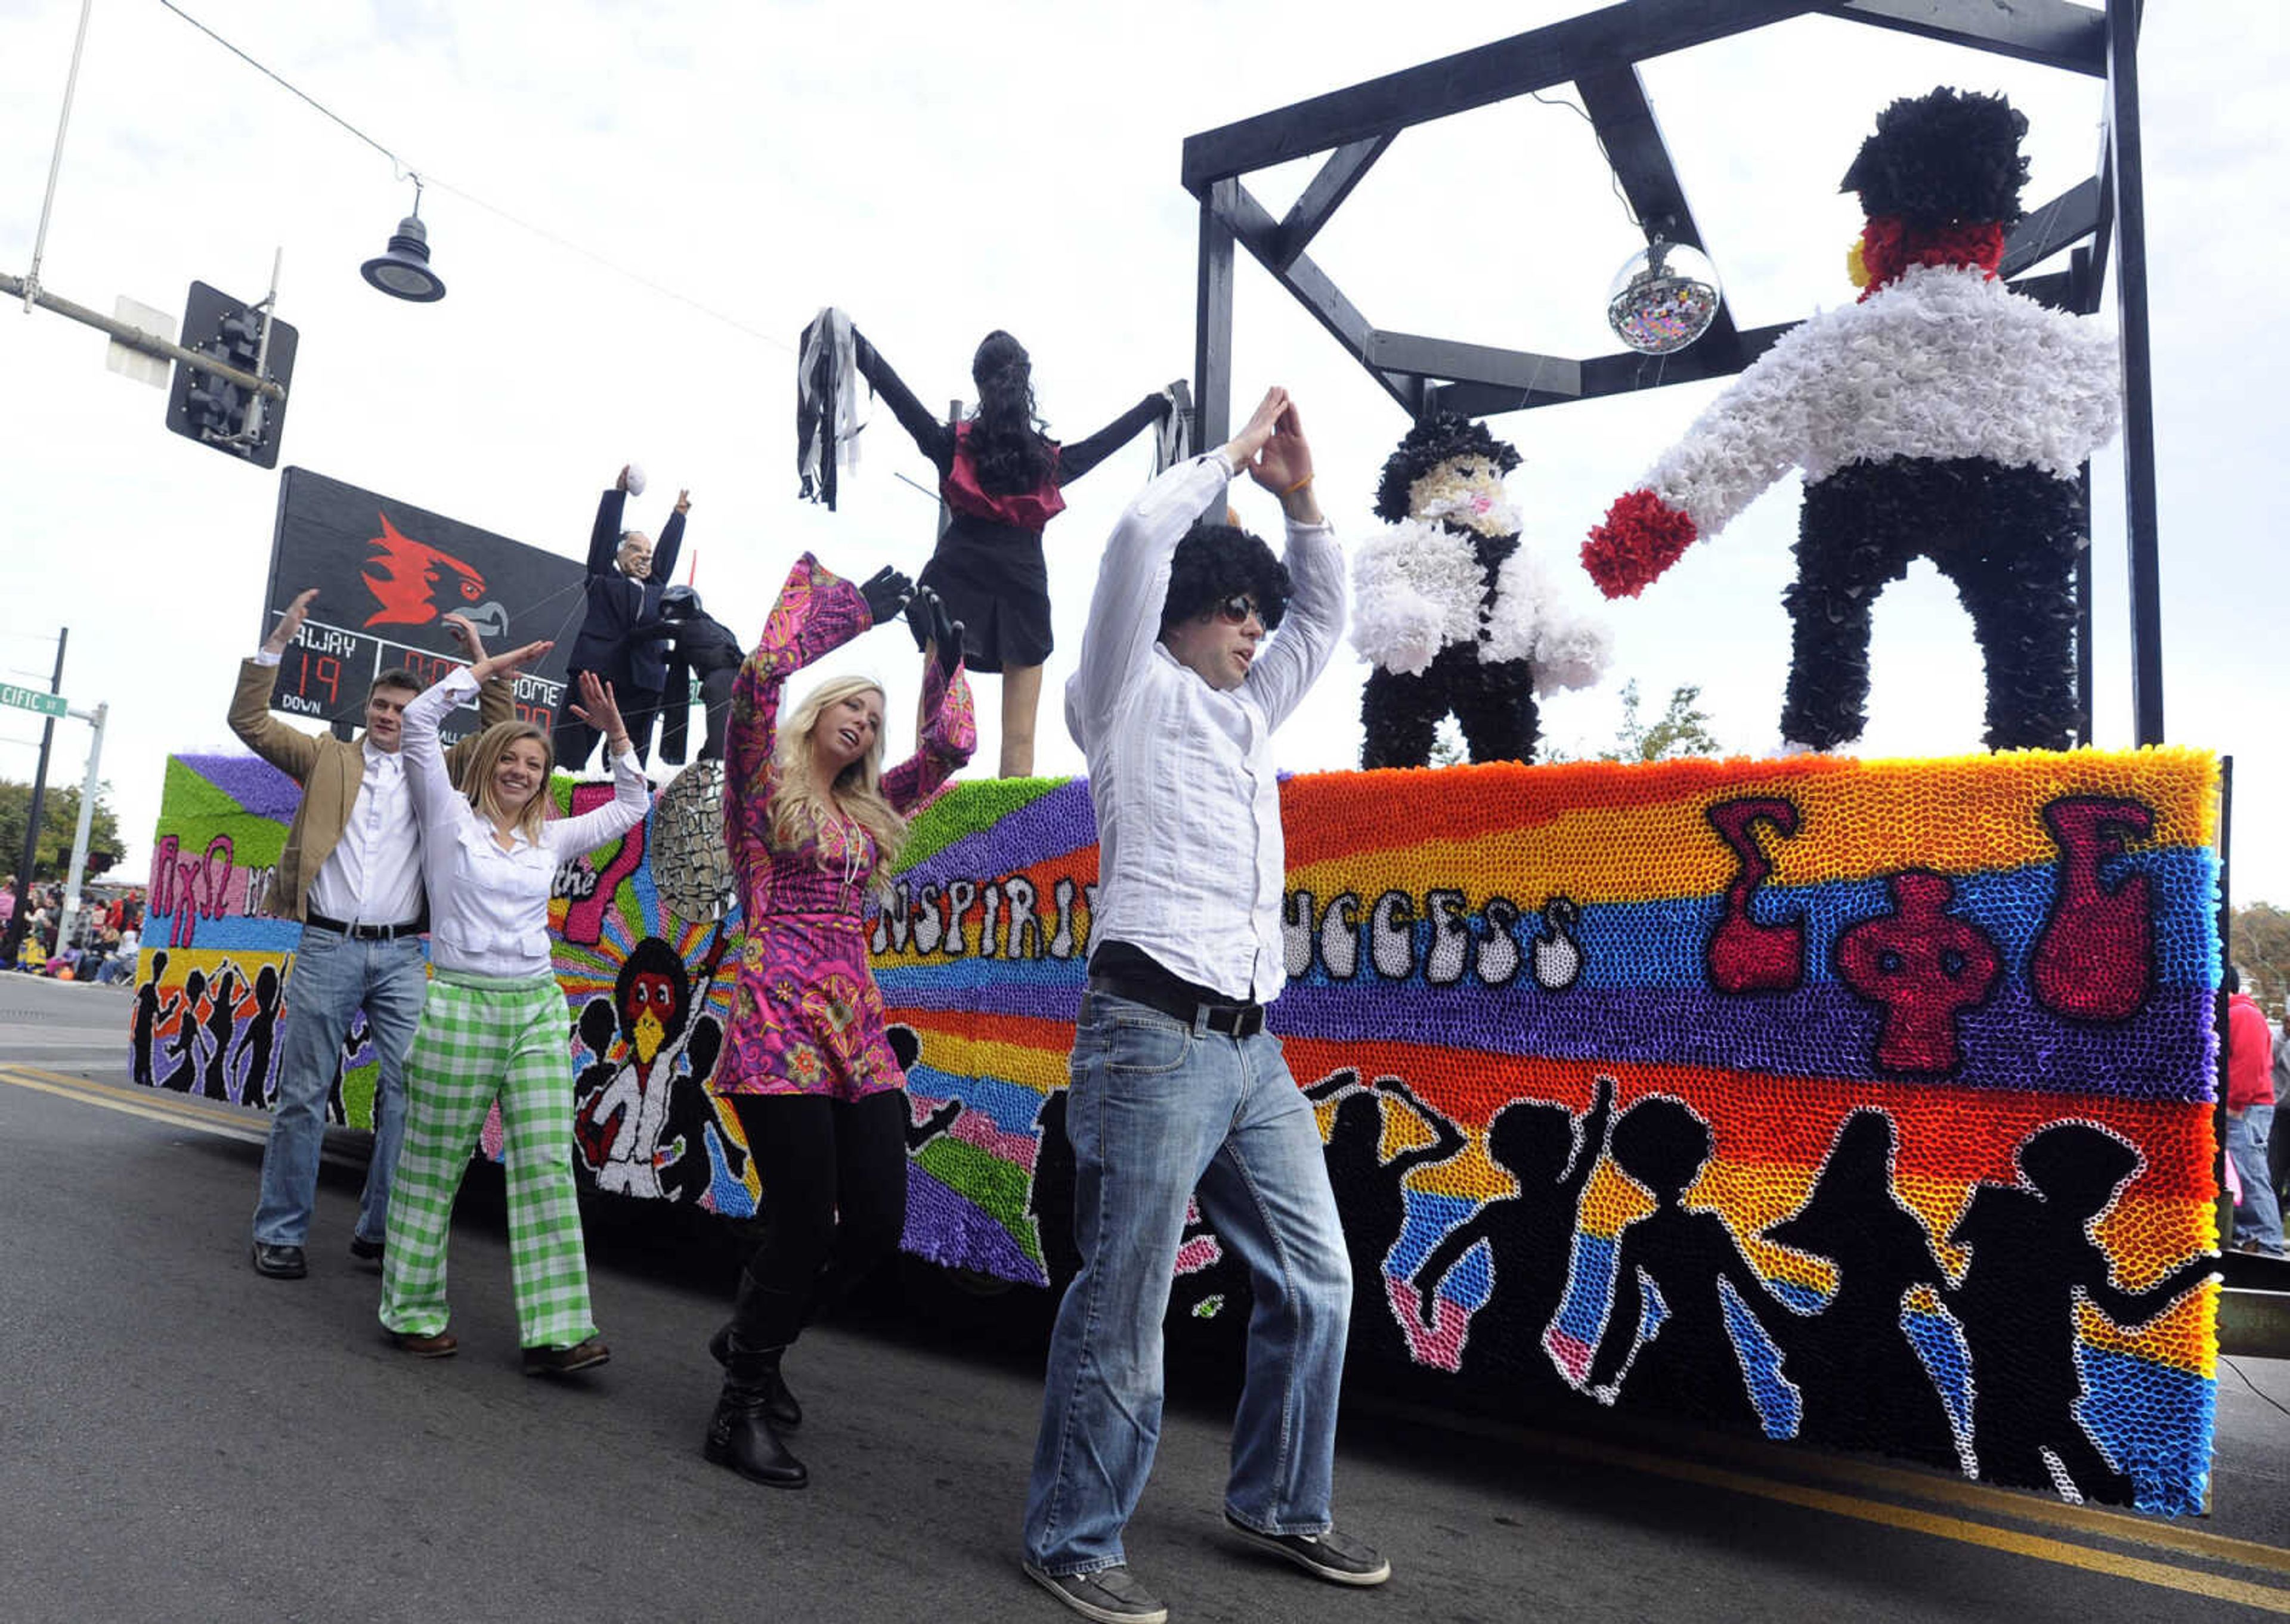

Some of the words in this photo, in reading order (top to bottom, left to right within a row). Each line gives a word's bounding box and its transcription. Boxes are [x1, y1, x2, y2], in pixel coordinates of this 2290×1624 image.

[299, 652, 341, 704] 19
[1, 687, 40, 709] CIFIC
[283, 694, 321, 714] DOWN
[871, 875, 1101, 960] NSPIRI
[1282, 888, 1582, 991] UCCESS
